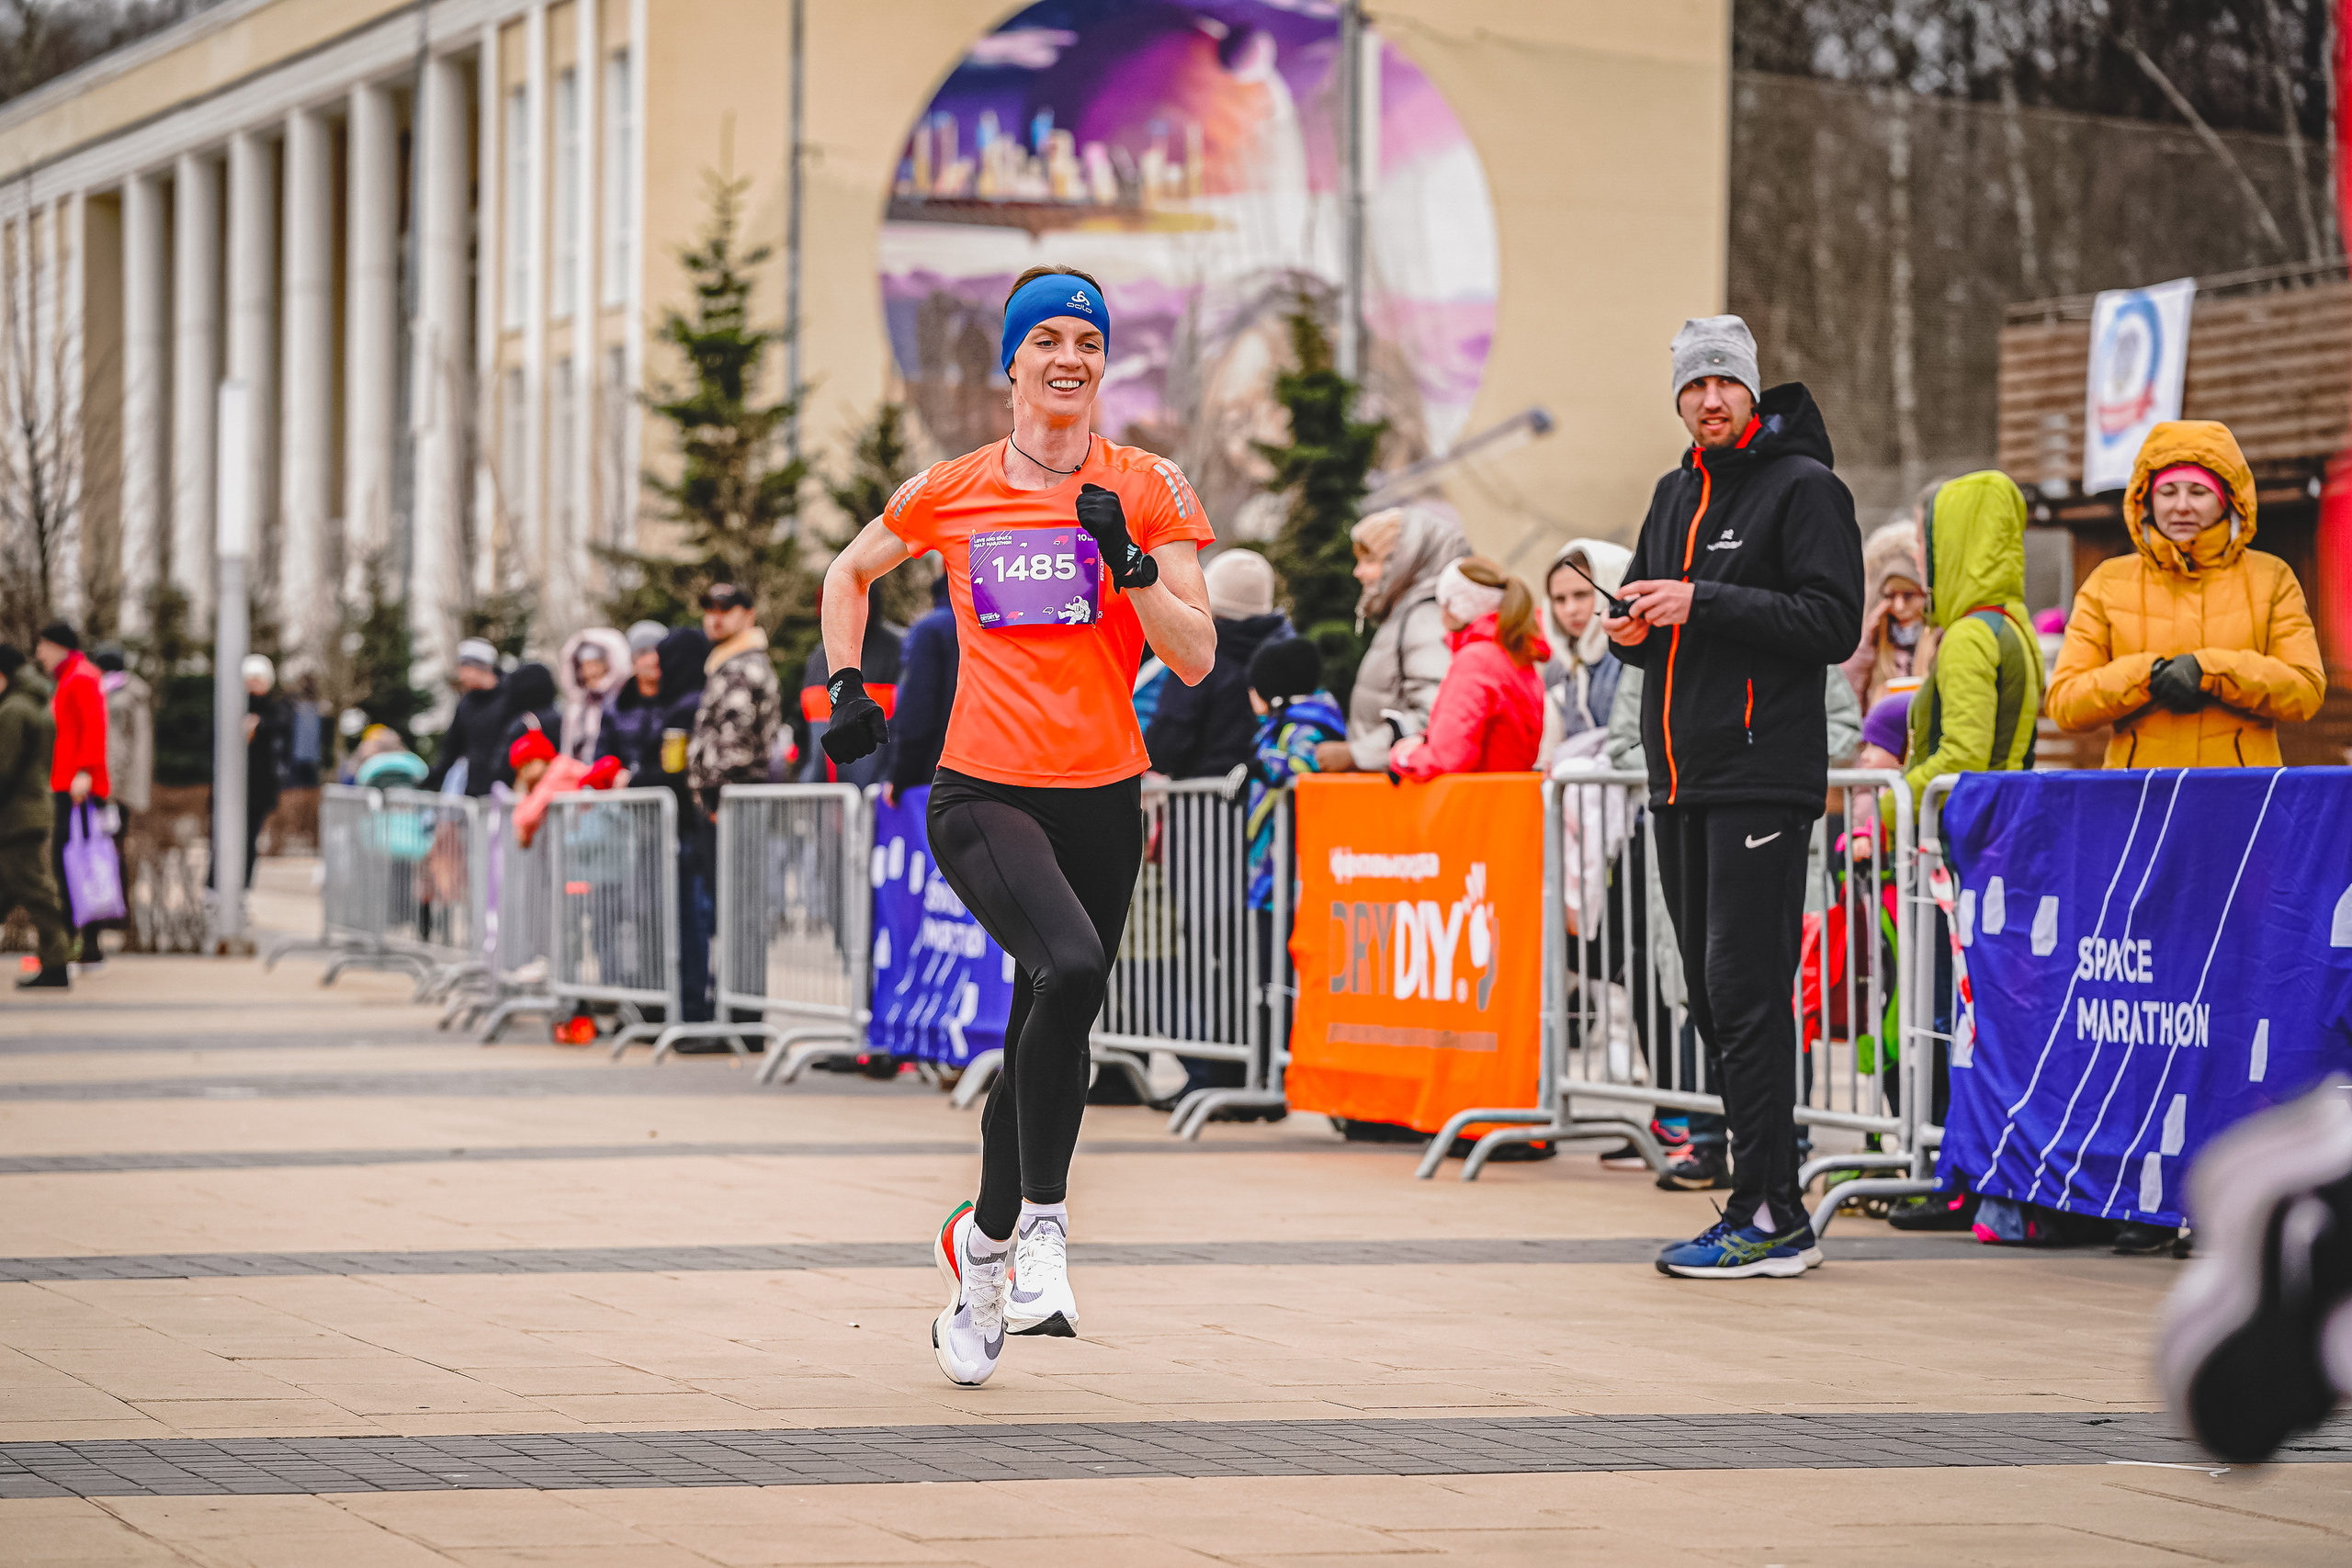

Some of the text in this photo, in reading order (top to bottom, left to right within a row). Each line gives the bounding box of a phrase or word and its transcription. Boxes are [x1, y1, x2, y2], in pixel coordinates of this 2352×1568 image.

[1067, 302, 1092, 313] odlo
[991, 554, 1077, 582] 1485
[2078, 935, 2154, 984] SPACE
